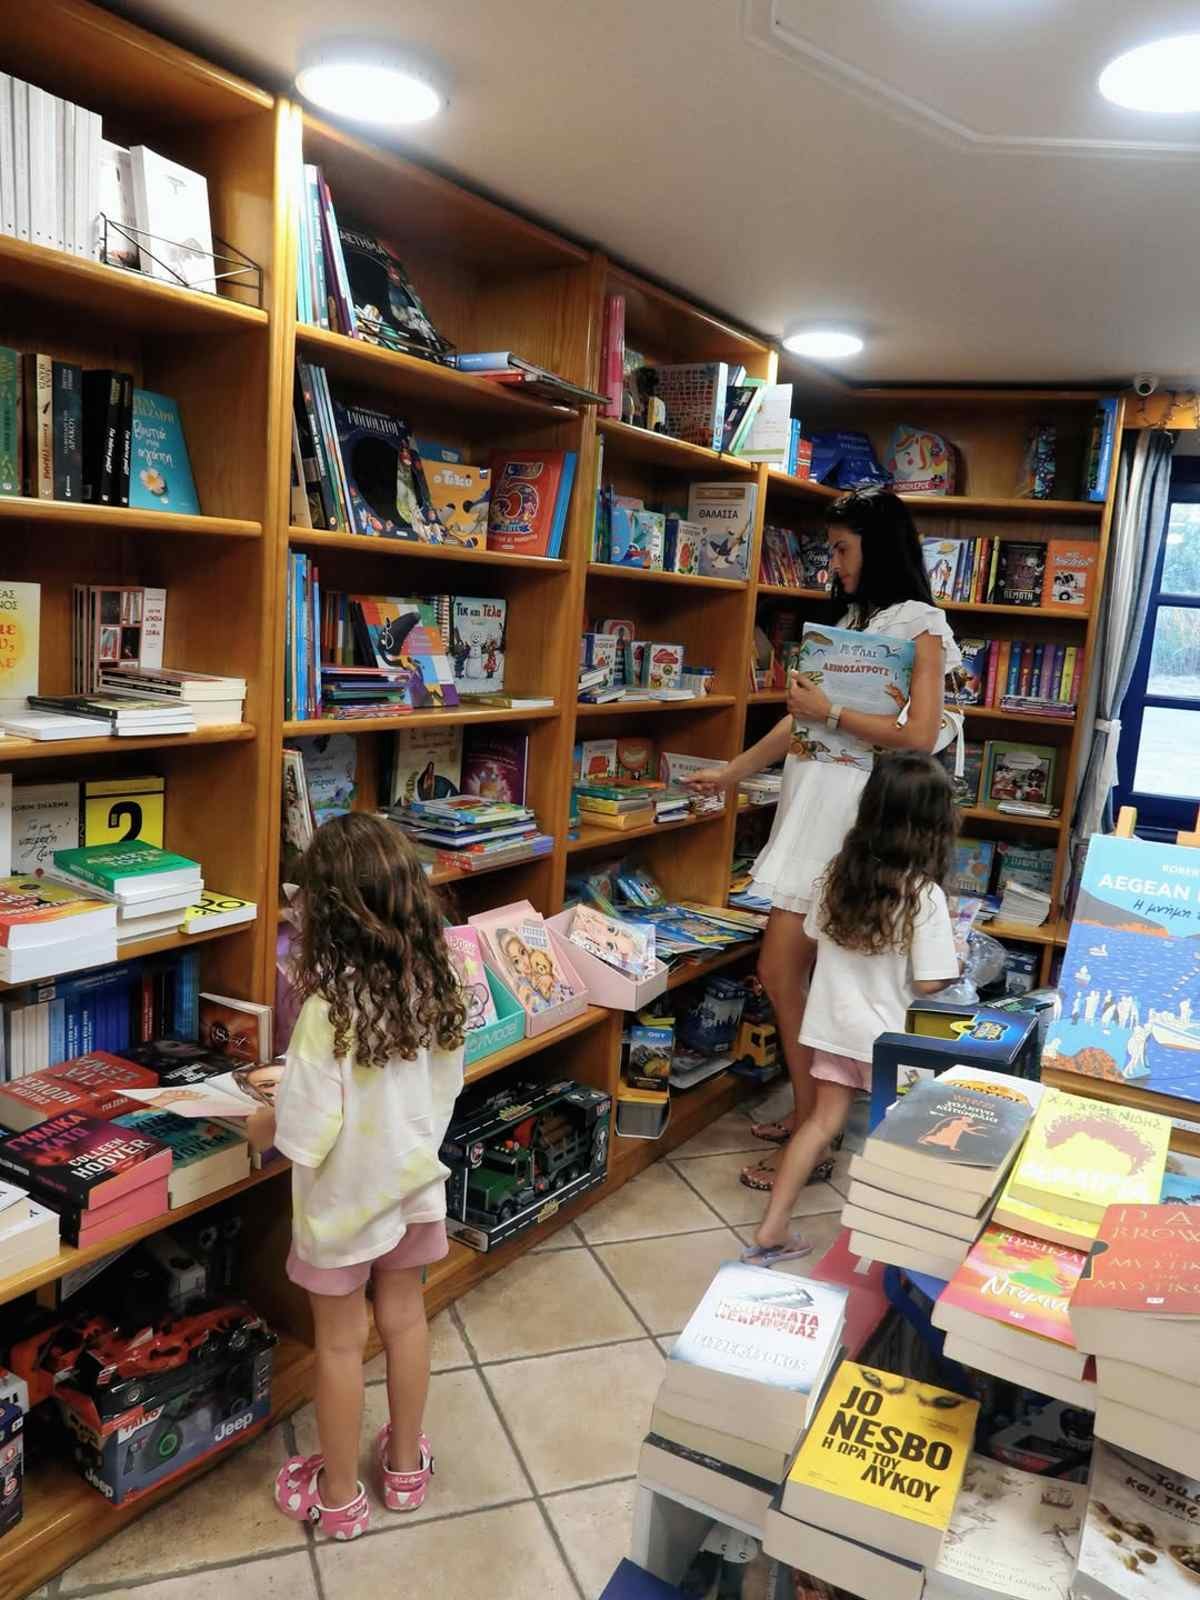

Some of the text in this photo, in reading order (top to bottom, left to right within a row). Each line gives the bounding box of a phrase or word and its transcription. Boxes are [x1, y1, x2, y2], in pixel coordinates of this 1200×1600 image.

[698, 509, 738, 519] ΘΑΛΑΣΣΑ
[1097, 873, 1191, 901] AEGEAN
[68, 1137, 126, 1167] COLLEEN
[70, 1138, 152, 1180] HOOVER
[839, 1385, 884, 1417] JO
[214, 1412, 255, 1442] Jeep
[827, 1409, 953, 1471] NESBO
[821, 1436, 902, 1471] Η ΩΡΑ ΤΟΥ
[84, 1468, 114, 1498] Jeep
[860, 1463, 941, 1503] ΛΥΚΟΥ
